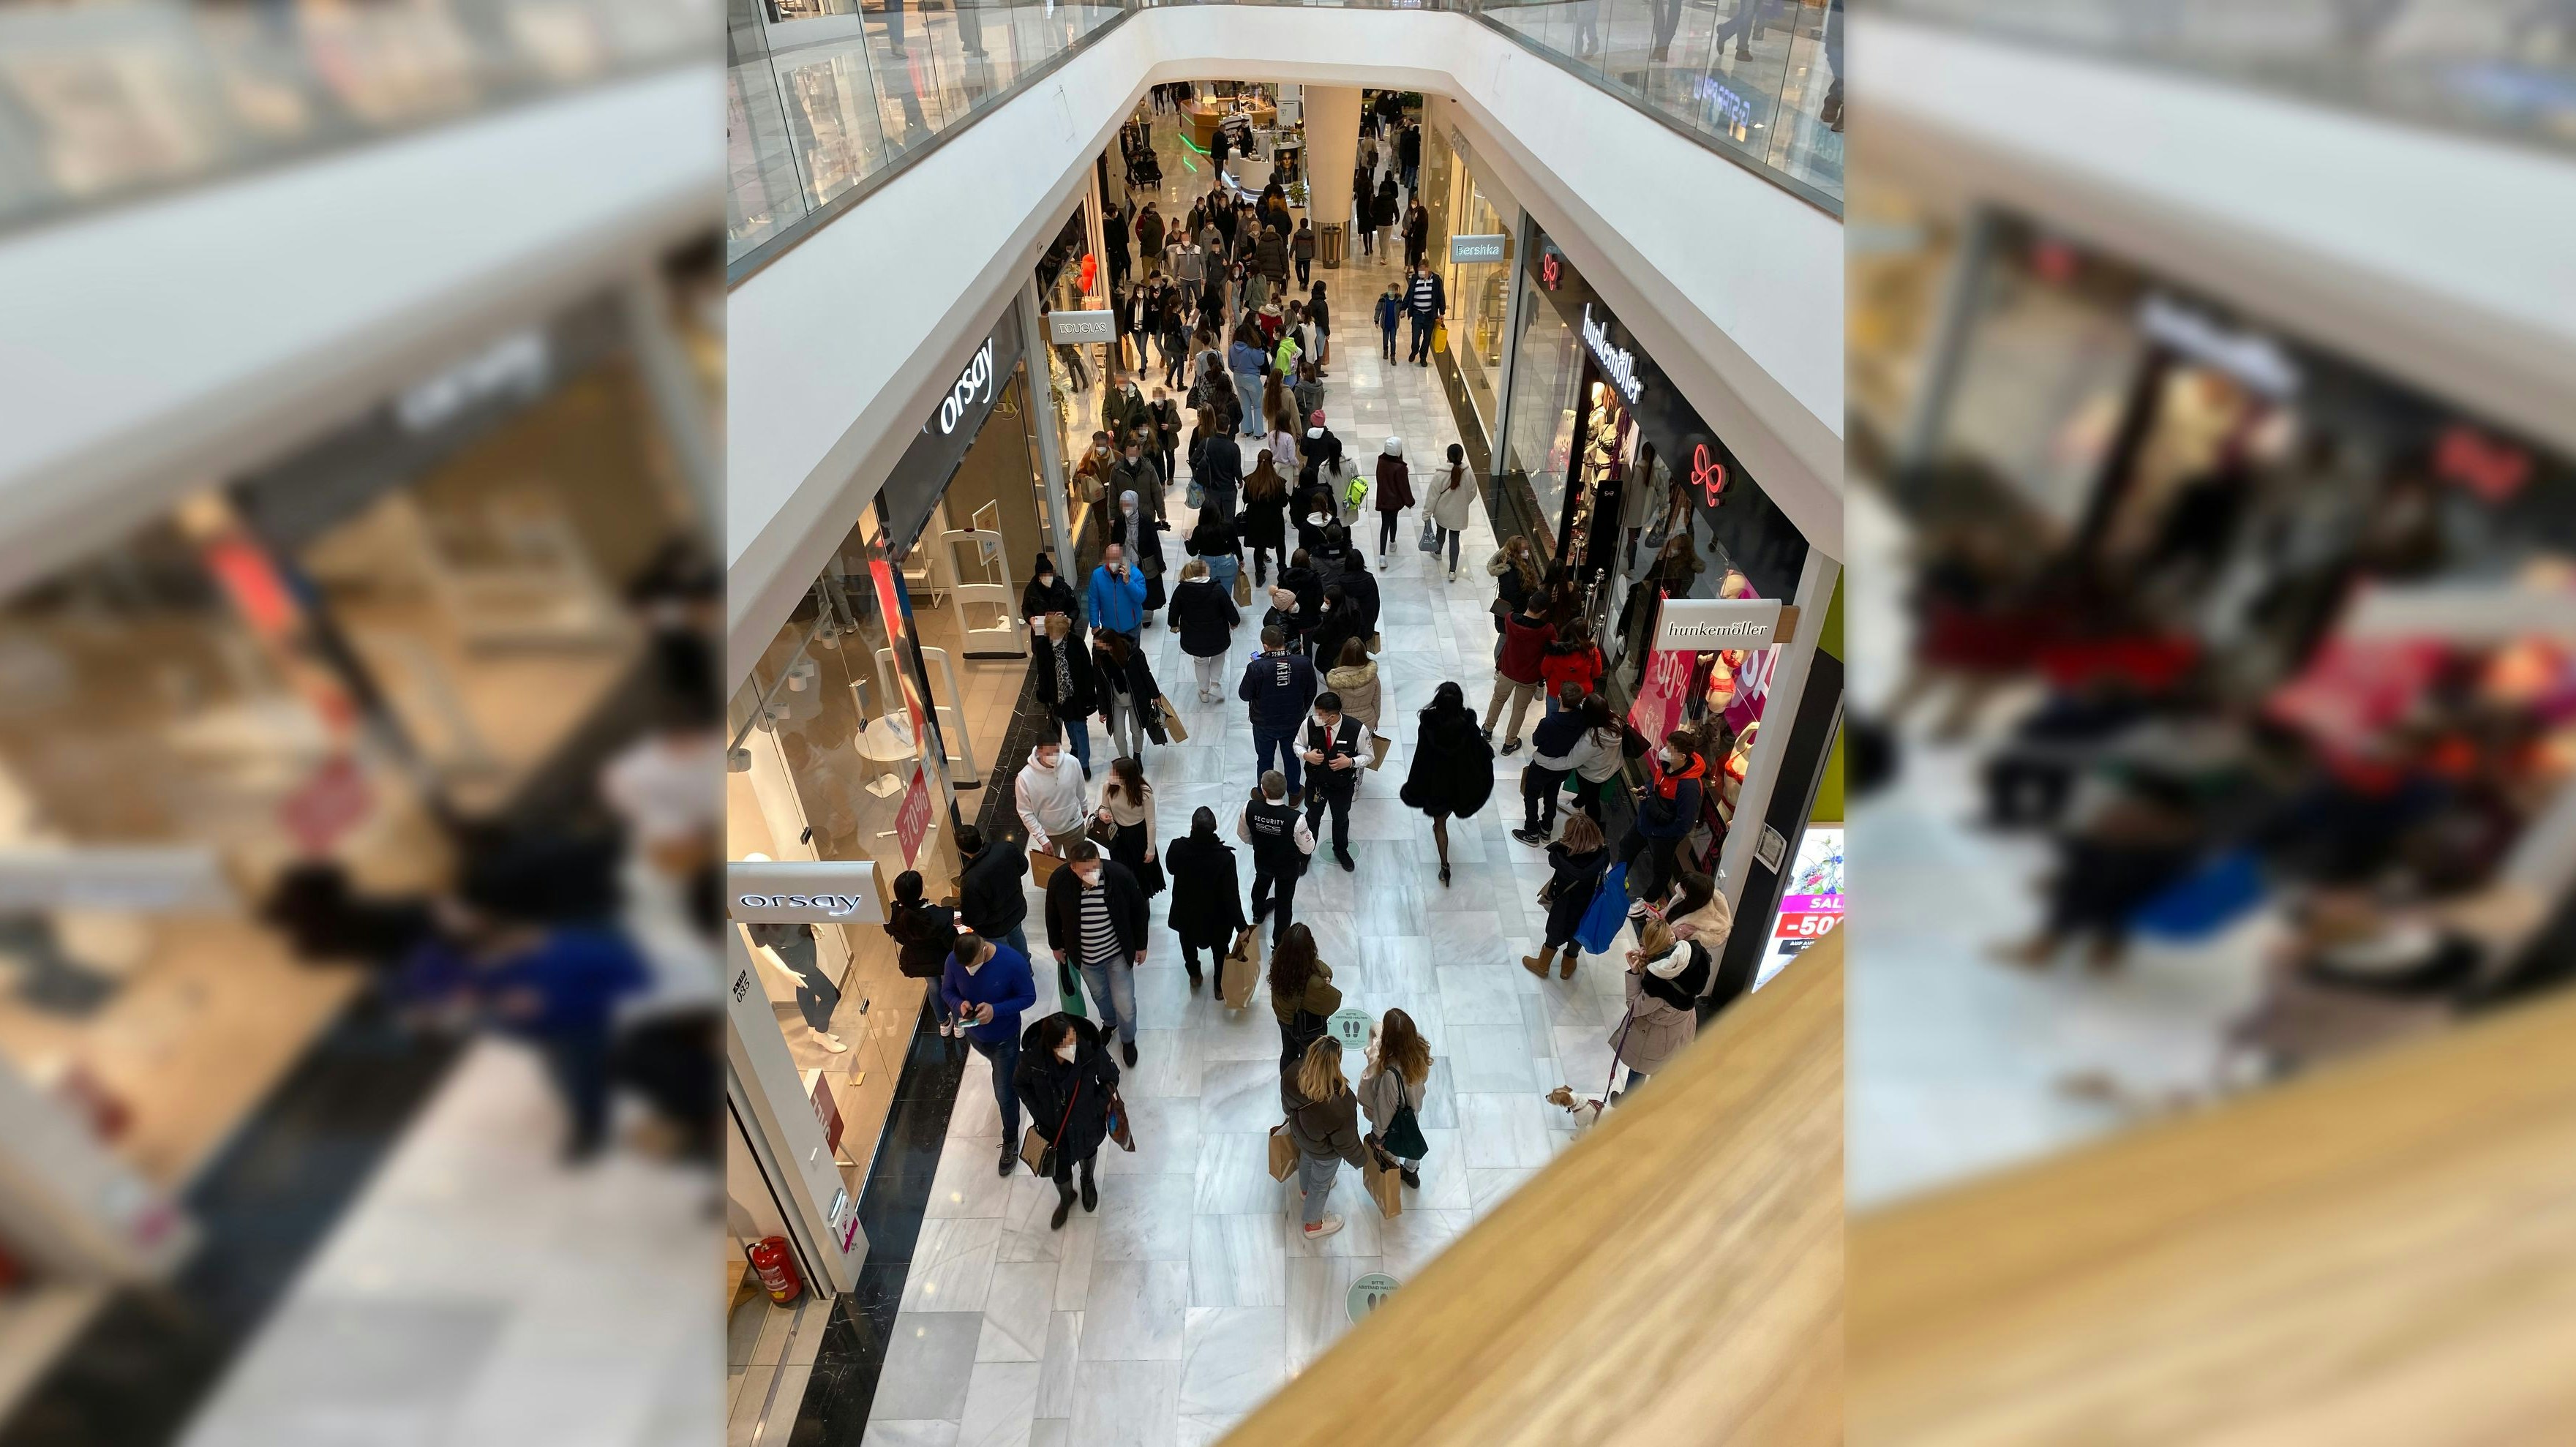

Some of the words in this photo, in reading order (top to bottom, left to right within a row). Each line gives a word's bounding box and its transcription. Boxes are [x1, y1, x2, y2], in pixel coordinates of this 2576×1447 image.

[1456, 244, 1500, 256] Bershka
[1059, 323, 1107, 334] DOUGLAS
[1582, 302, 1643, 405] hunkemöller
[940, 337, 992, 435] orsay
[1668, 621, 1768, 636] hunkemöller
[1277, 662, 1288, 687] CREW
[1254, 815, 1285, 826] SECURITY
[740, 895, 862, 916] orsay
[1809, 897, 1844, 909] SAL
[737, 977, 750, 1003] 035
